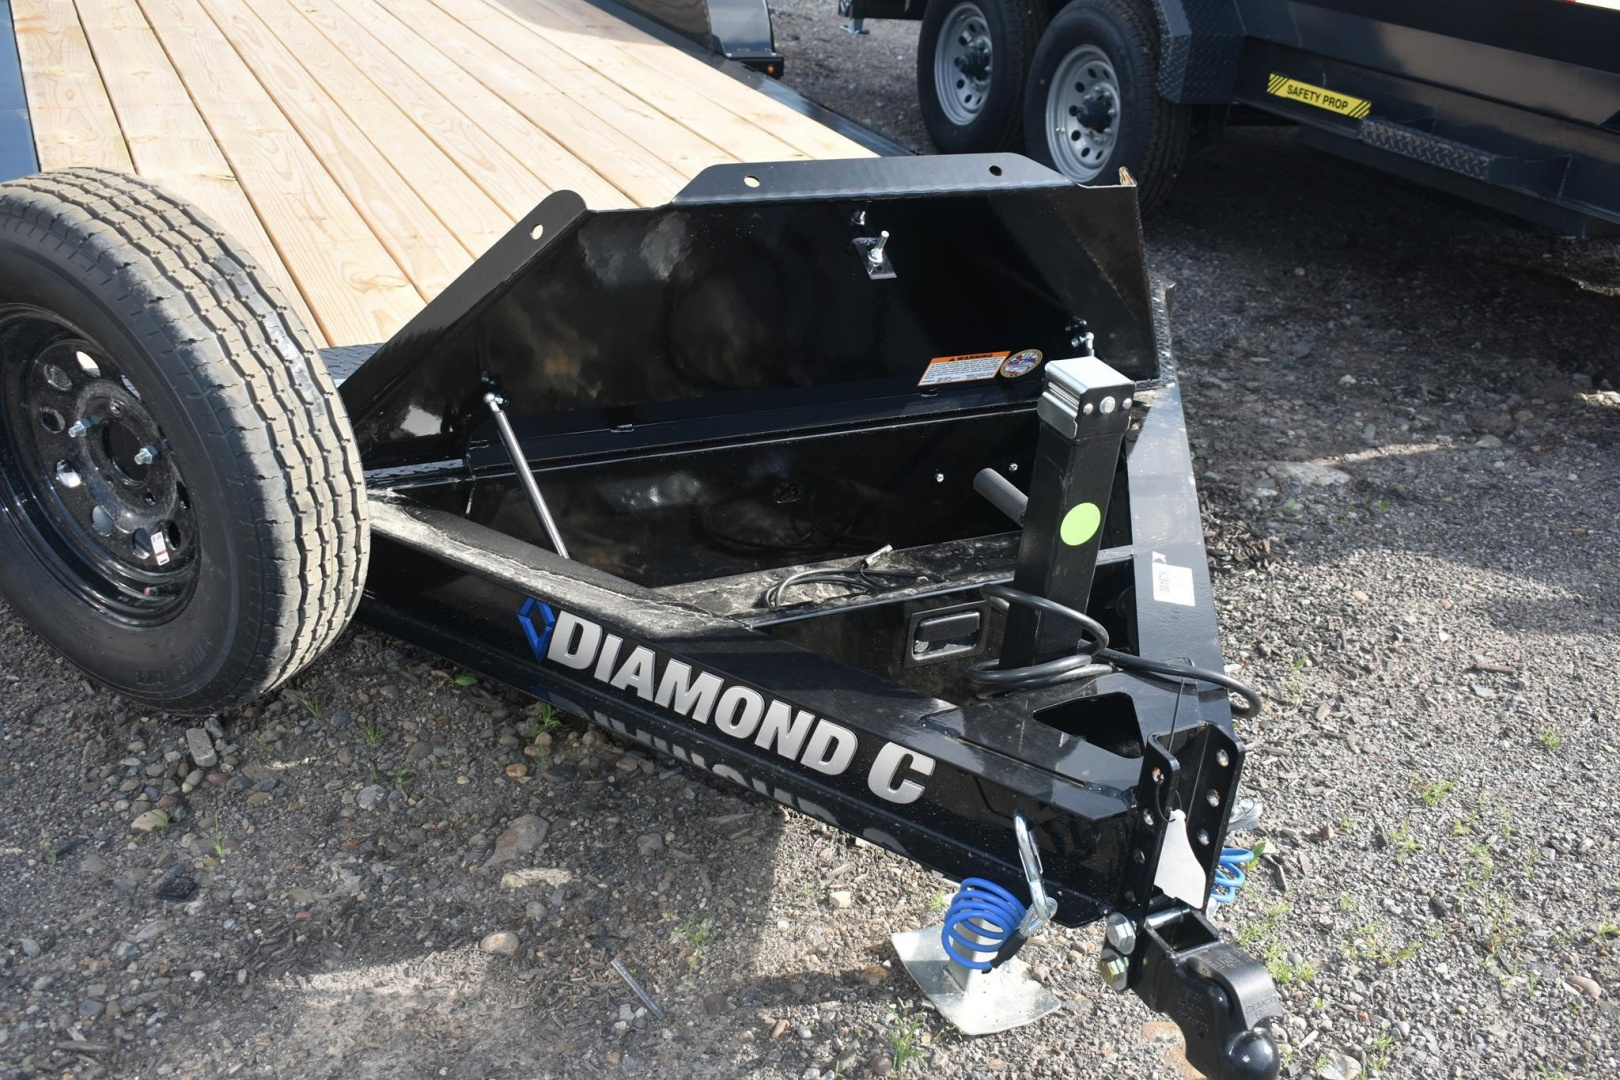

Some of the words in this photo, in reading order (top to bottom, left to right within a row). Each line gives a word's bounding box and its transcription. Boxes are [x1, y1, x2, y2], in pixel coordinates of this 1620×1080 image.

[1286, 84, 1322, 103] SAFETY
[1322, 95, 1349, 110] PROP
[957, 353, 993, 361] WARNING
[547, 609, 859, 776] DIAMOND
[867, 741, 937, 805] C
[1245, 995, 1277, 1015] DEMCO
